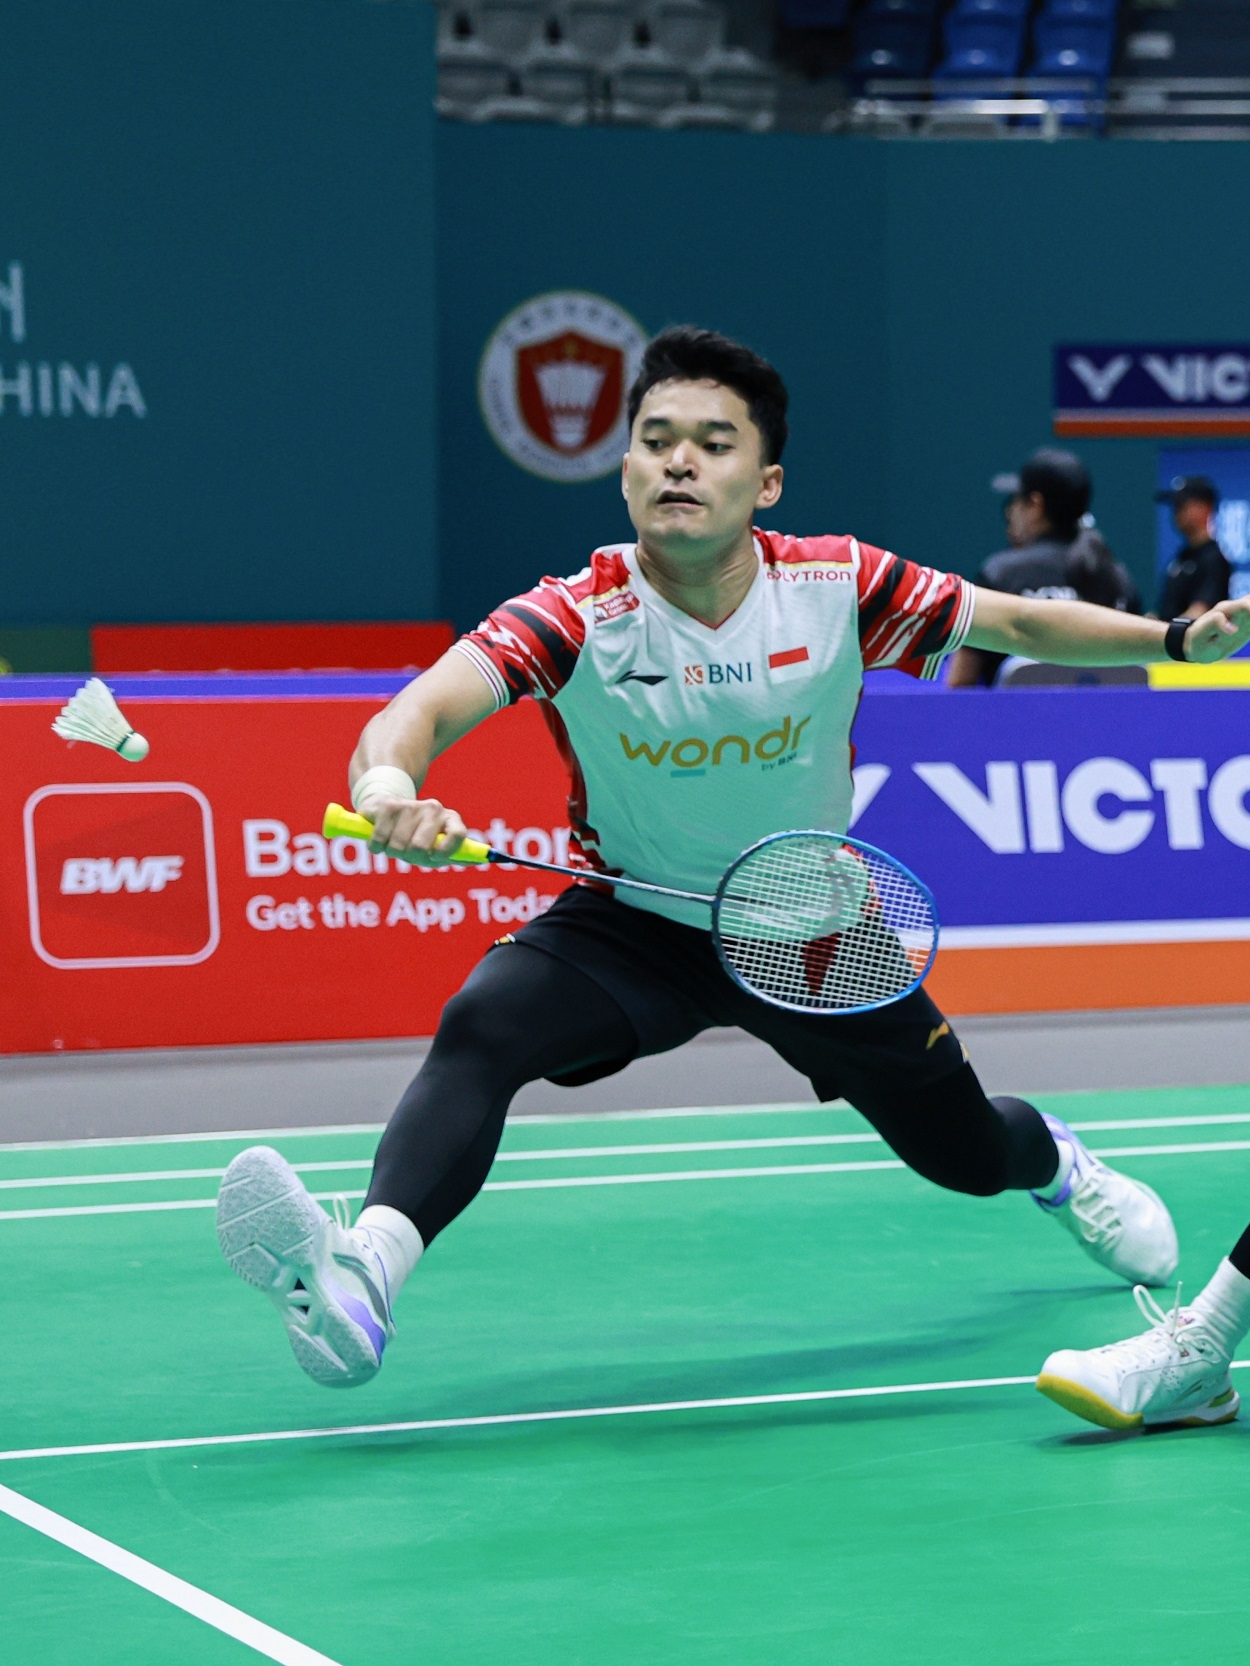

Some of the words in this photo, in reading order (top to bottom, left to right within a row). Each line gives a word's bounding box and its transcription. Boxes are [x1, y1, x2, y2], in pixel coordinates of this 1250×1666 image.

[709, 662, 753, 685] BNI
[619, 715, 811, 767] wondr
[60, 856, 184, 895] BWF
[247, 895, 314, 930] Get
[318, 892, 380, 928] the
[387, 891, 465, 932] App
